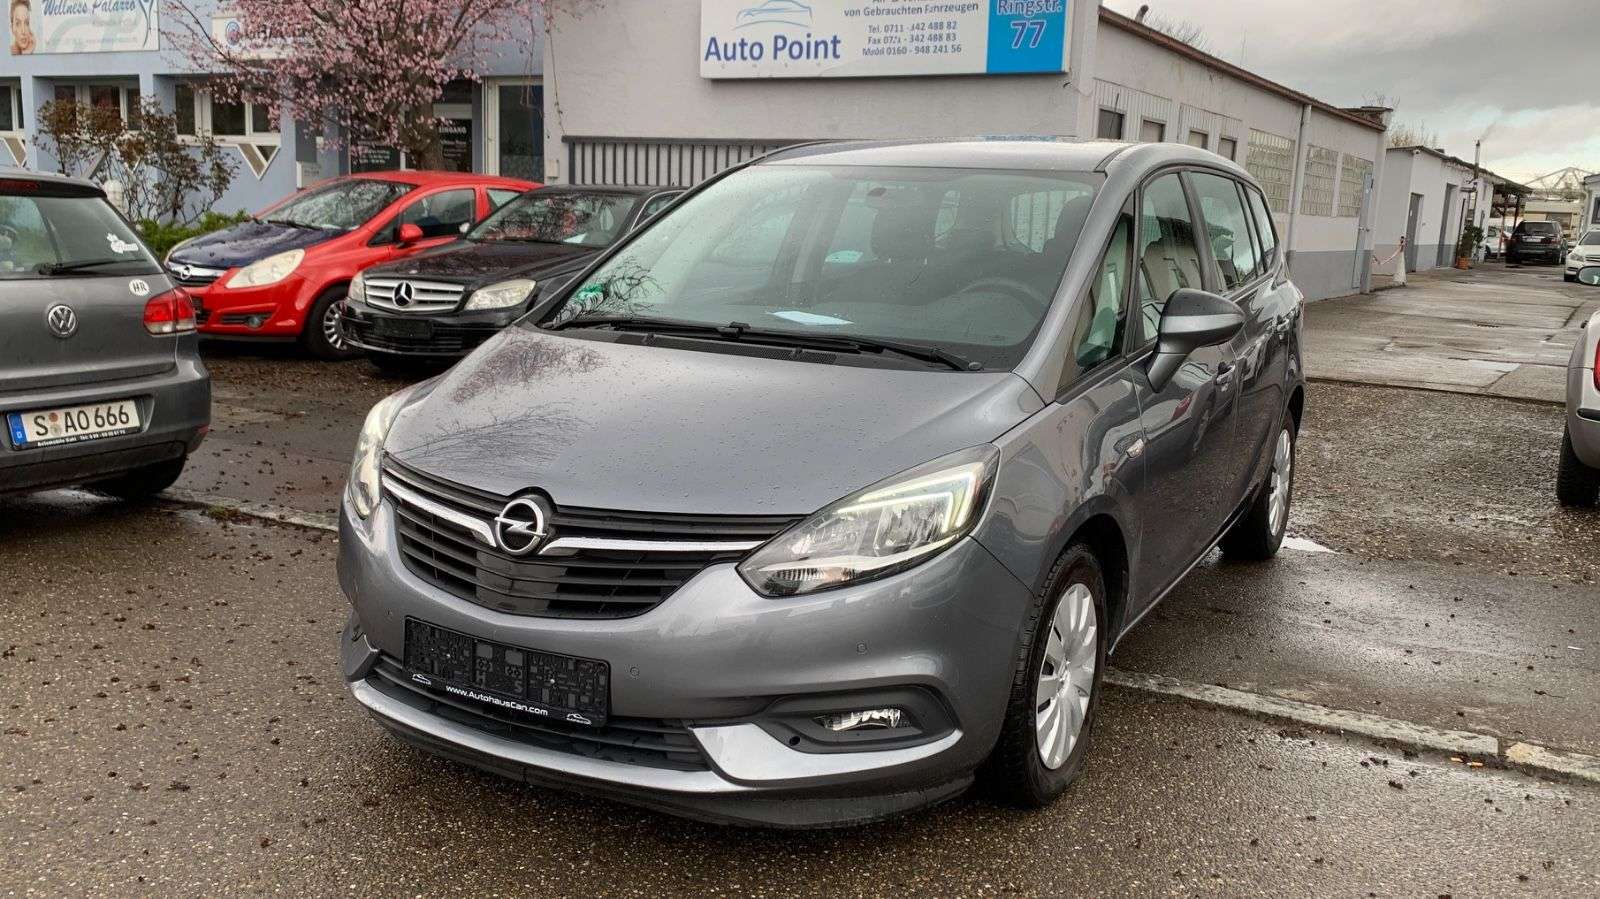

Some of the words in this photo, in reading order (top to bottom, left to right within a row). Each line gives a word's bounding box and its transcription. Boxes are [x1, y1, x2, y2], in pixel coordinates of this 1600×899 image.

[43, 0, 87, 15] Wellness
[91, 0, 136, 16] Palazzo
[844, 9, 860, 17] von
[863, 5, 923, 17] Gebrauchten
[996, 0, 1063, 18] Ringstr.
[867, 24, 883, 34] Tel.
[884, 23, 904, 33] 0711
[946, 20, 957, 30] 82
[1010, 19, 1047, 49] 77
[867, 36, 881, 45] Fax
[945, 32, 957, 42] 83
[704, 36, 764, 62] Auto
[773, 32, 842, 61] Point
[886, 46, 907, 56] 0160
[915, 45, 930, 55] 948
[932, 44, 949, 54] 241
[951, 43, 962, 53] 56
[133, 281, 147, 292] HR
[33, 415, 49, 436] S
[64, 410, 90, 433] AO
[94, 404, 130, 428] 666
[16, 431, 23, 439] D
[445, 685, 549, 716] www.AutohausCan.com
